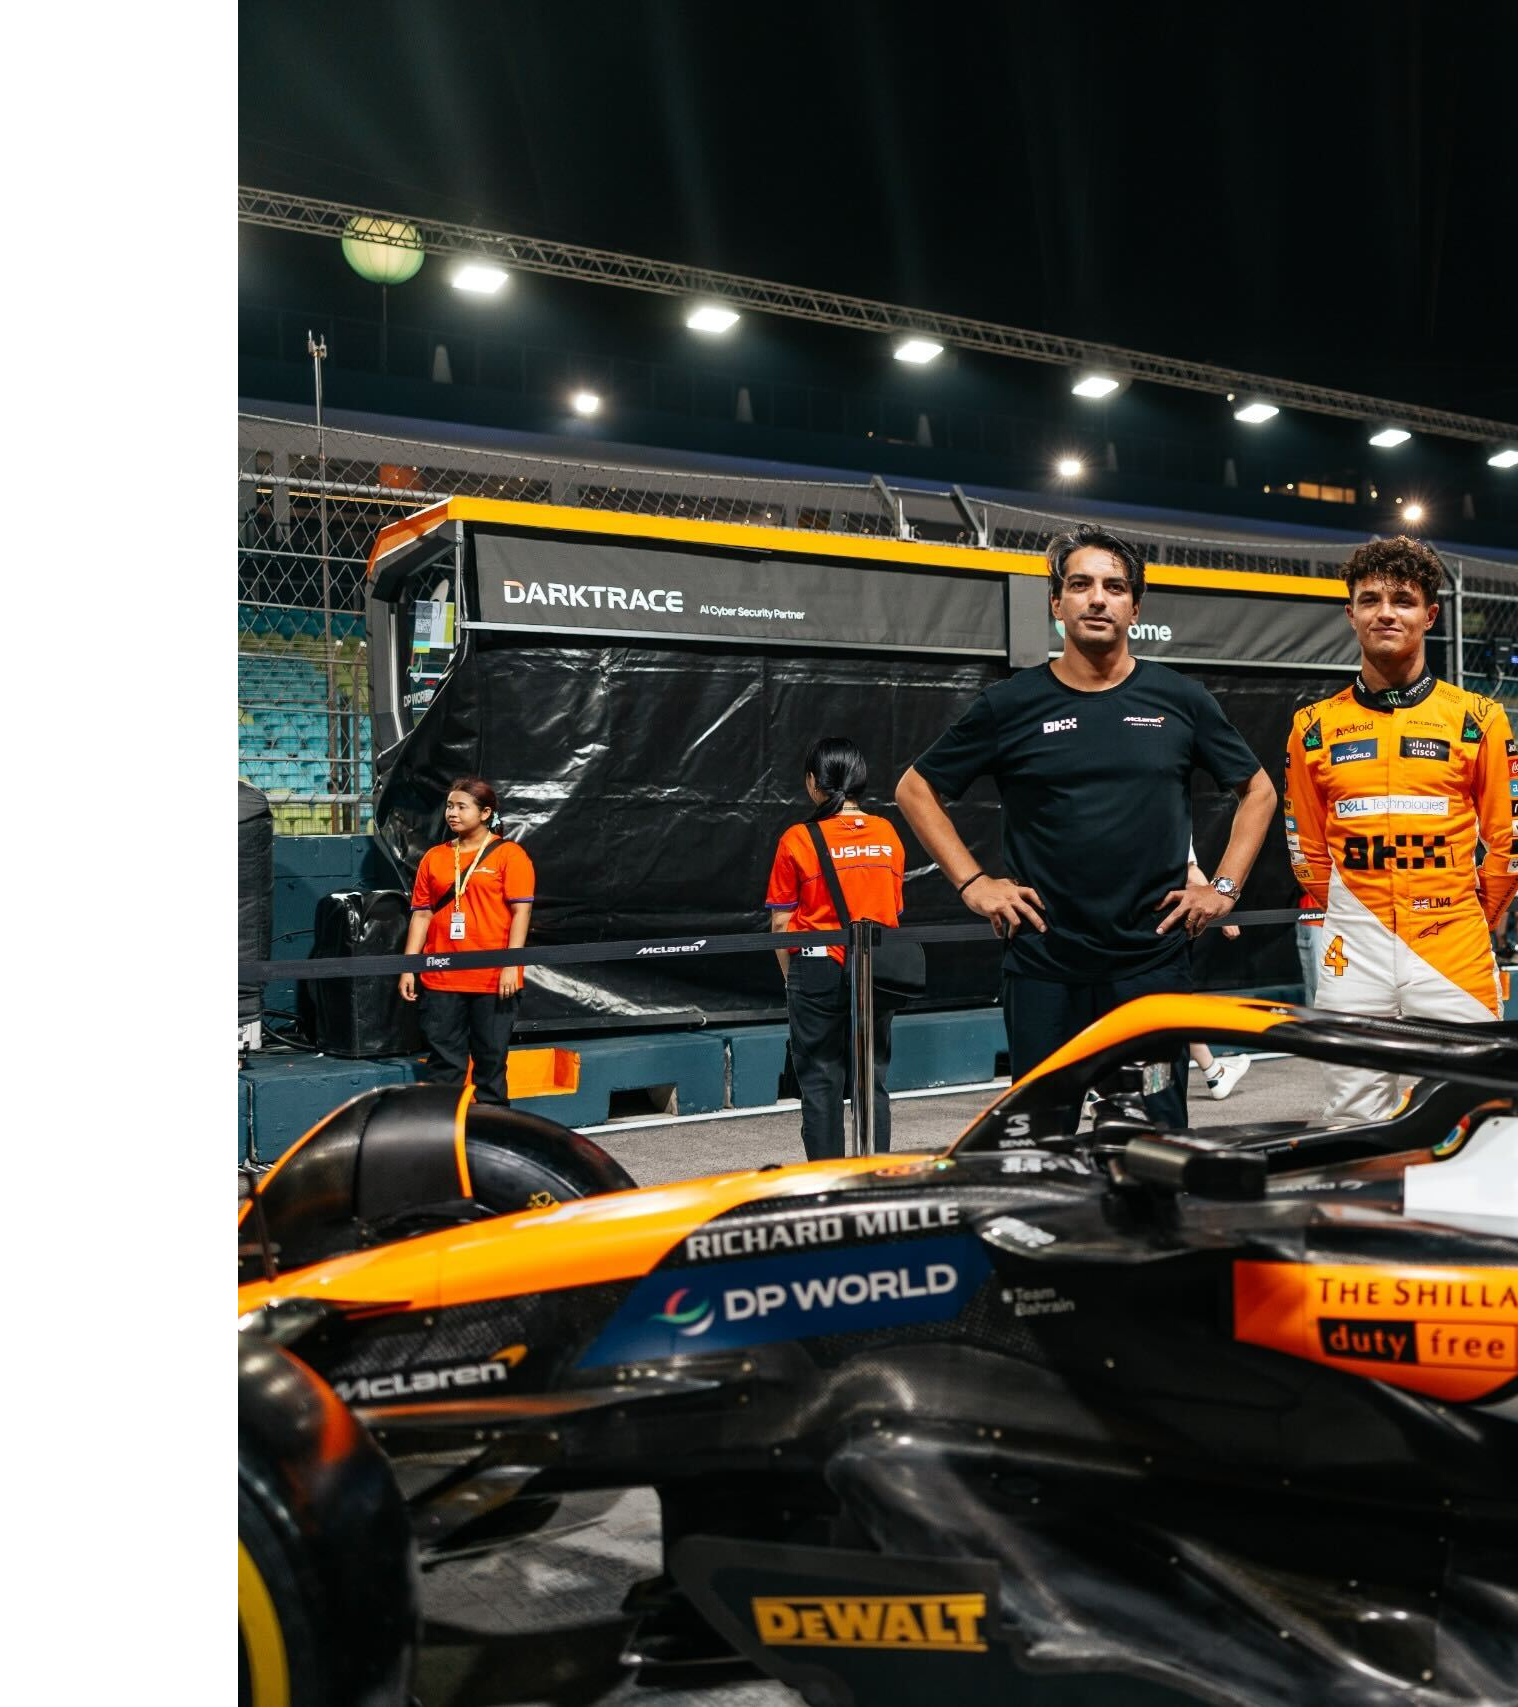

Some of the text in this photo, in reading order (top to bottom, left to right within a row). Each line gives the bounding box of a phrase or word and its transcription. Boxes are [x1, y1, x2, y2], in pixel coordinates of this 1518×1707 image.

[503, 579, 684, 613] DARKTRACE
[700, 605, 805, 621] AI Cyber Security Partner
[1128, 624, 1172, 642] ome
[1043, 718, 1077, 734] OKX
[1123, 716, 1161, 724] McLaren
[1336, 722, 1374, 738] Android
[1336, 752, 1371, 763] DP WORLD
[1411, 749, 1436, 757] CISCO
[1338, 797, 1446, 814] DELL Technologies
[830, 844, 893, 859] USHER
[1343, 834, 1446, 870] OKX
[1429, 896, 1451, 909] LN4
[1298, 912, 1327, 921] McLar
[636, 943, 700, 955] McLaren
[1324, 935, 1348, 976] 4
[686, 1219, 843, 1261] RICHARD
[855, 1202, 961, 1239] MILLE
[724, 1264, 958, 1321] DP WORLD
[1014, 1287, 1056, 1301] Team
[1318, 1278, 1518, 1308] THE SHILLA
[1015, 1299, 1076, 1317] Bahrain
[1329, 1323, 1505, 1360] duty free
[332, 1363, 507, 1400] McLaren
